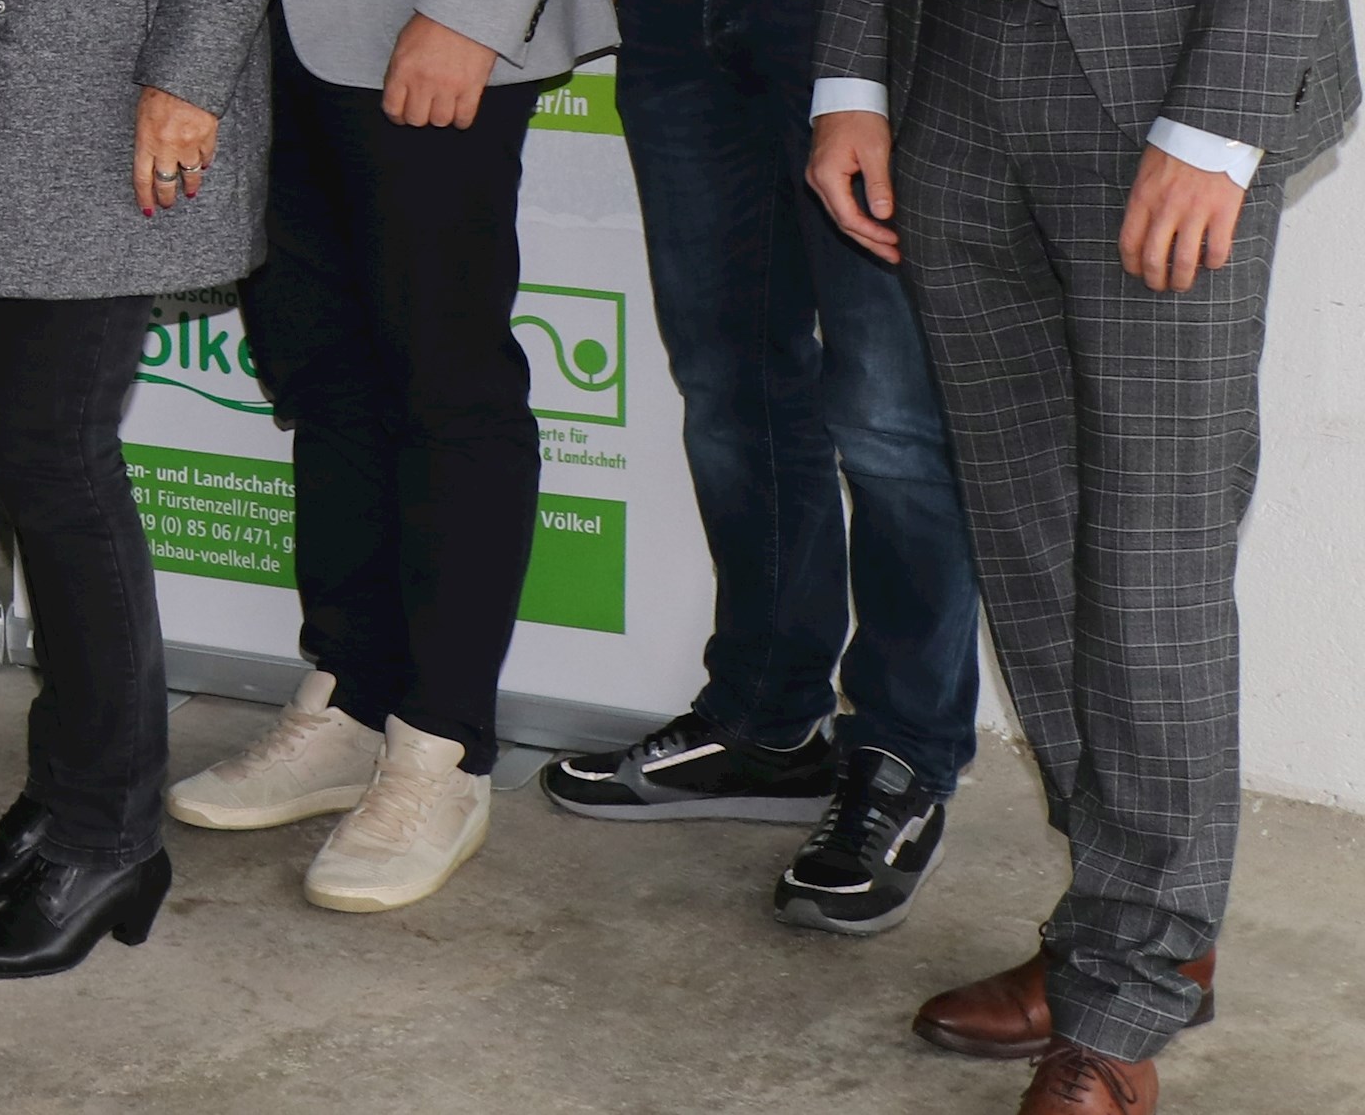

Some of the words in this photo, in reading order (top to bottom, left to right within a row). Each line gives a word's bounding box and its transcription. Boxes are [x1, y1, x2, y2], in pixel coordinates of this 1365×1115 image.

[570, 427, 588, 444] für
[543, 447, 553, 461] &
[557, 448, 627, 469] Landschaft
[157, 467, 187, 483] und
[541, 510, 601, 534] Völkel
[162, 516, 181, 535] (0)
[188, 520, 206, 536] 85
